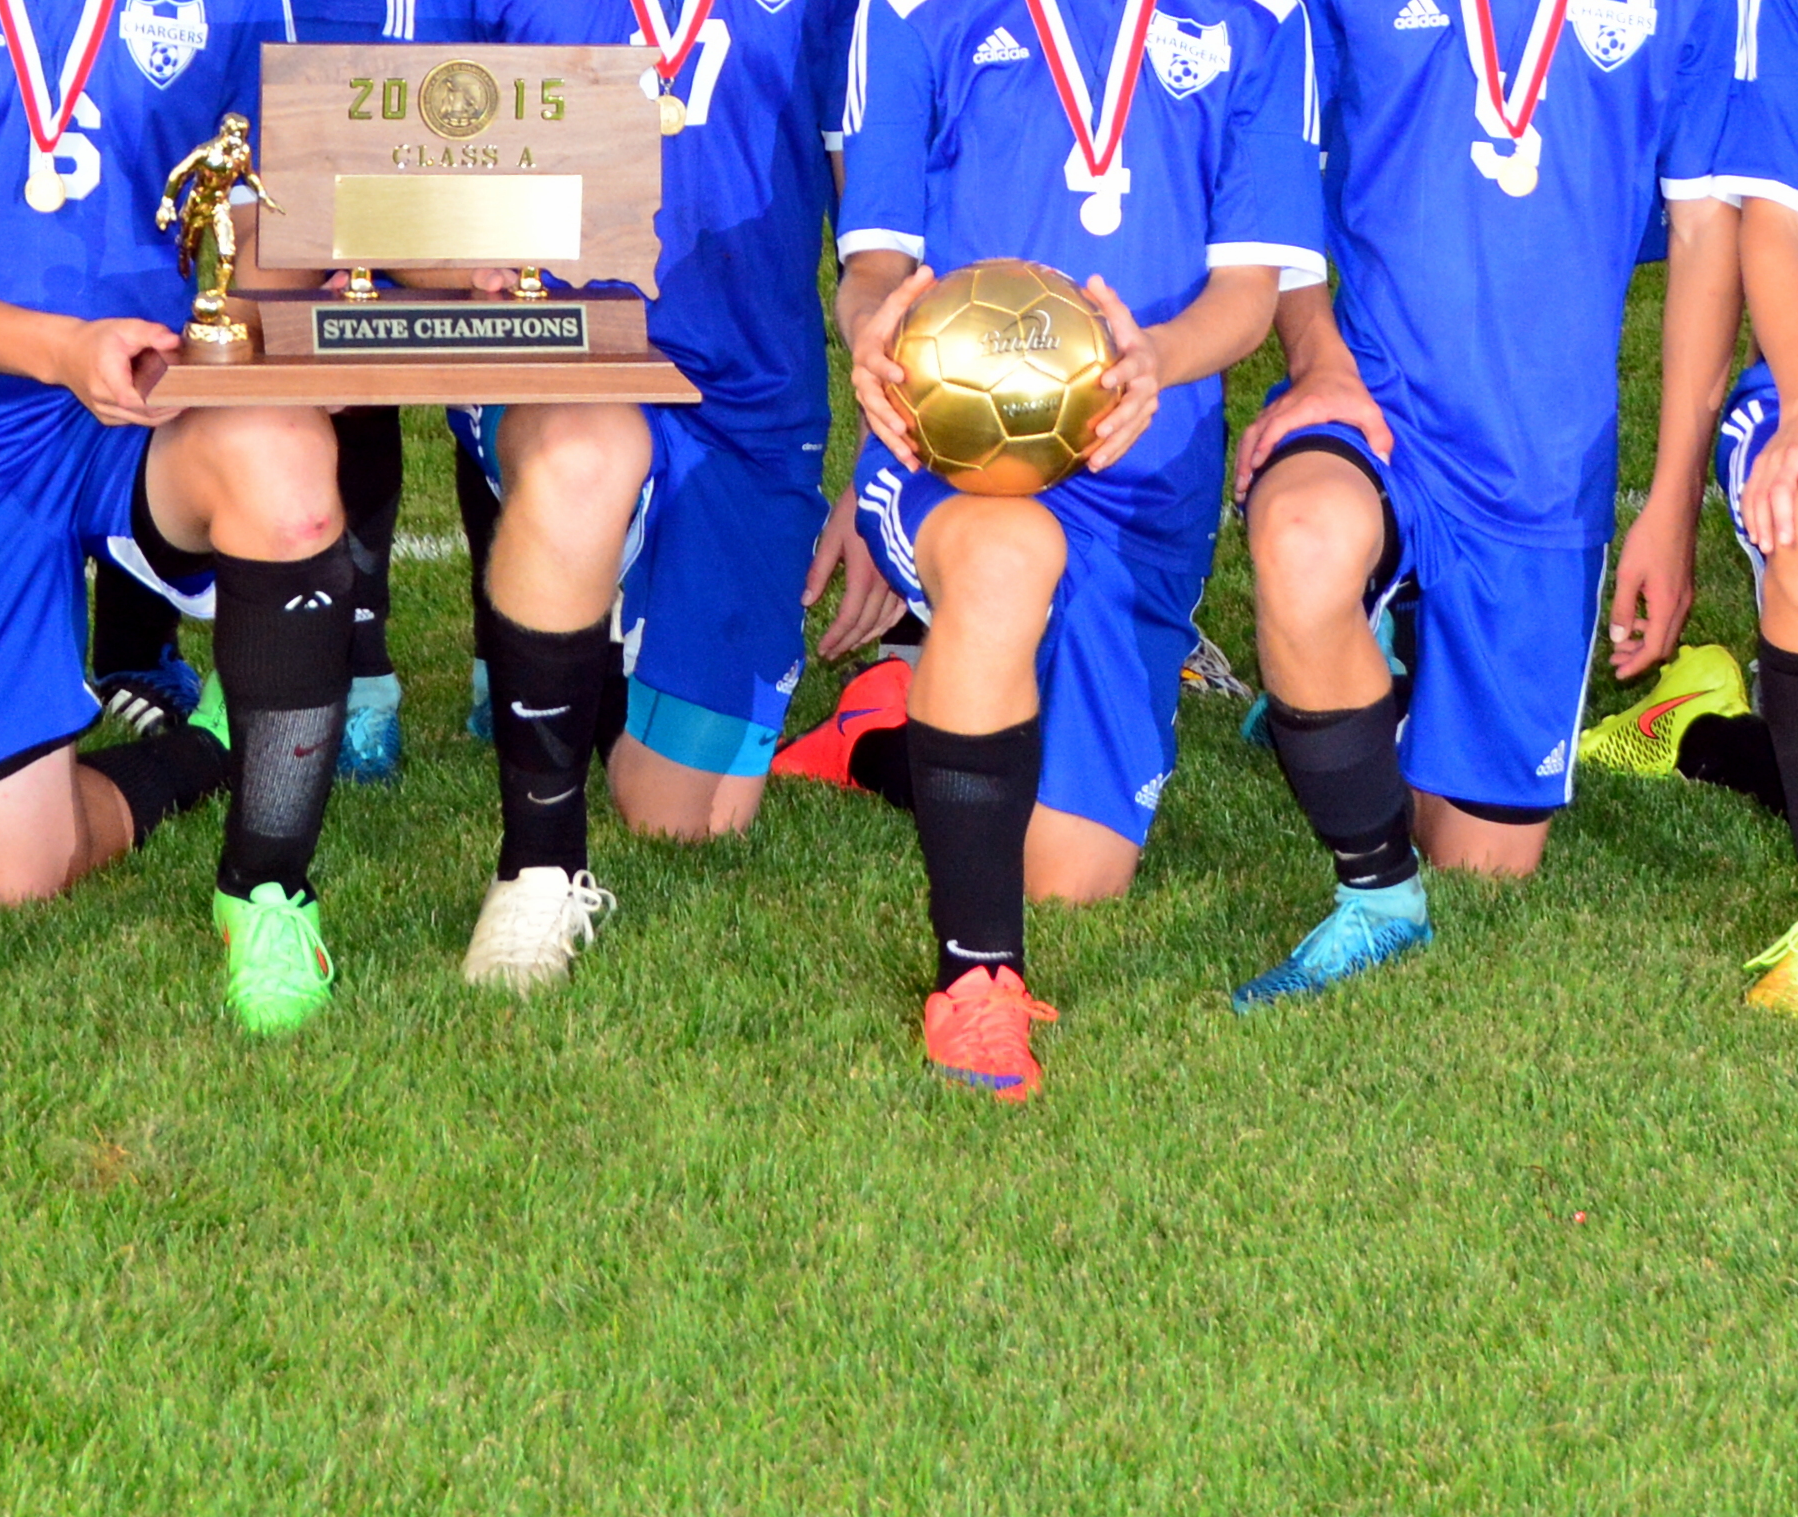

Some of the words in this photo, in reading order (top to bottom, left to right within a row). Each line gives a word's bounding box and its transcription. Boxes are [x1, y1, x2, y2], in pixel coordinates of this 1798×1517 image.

[1394, 13, 1450, 30] adidas
[1569, 6, 1653, 31] CHARGERS
[123, 20, 205, 46] CHARGERS
[973, 45, 1030, 65] adidas
[1145, 32, 1227, 66] CHARGERS
[348, 77, 408, 120] 20
[513, 78, 565, 120] 15
[392, 144, 499, 169] CLASS
[516, 145, 537, 169] A
[322, 318, 409, 340] STATE
[413, 317, 579, 339] CHAMPIONS
